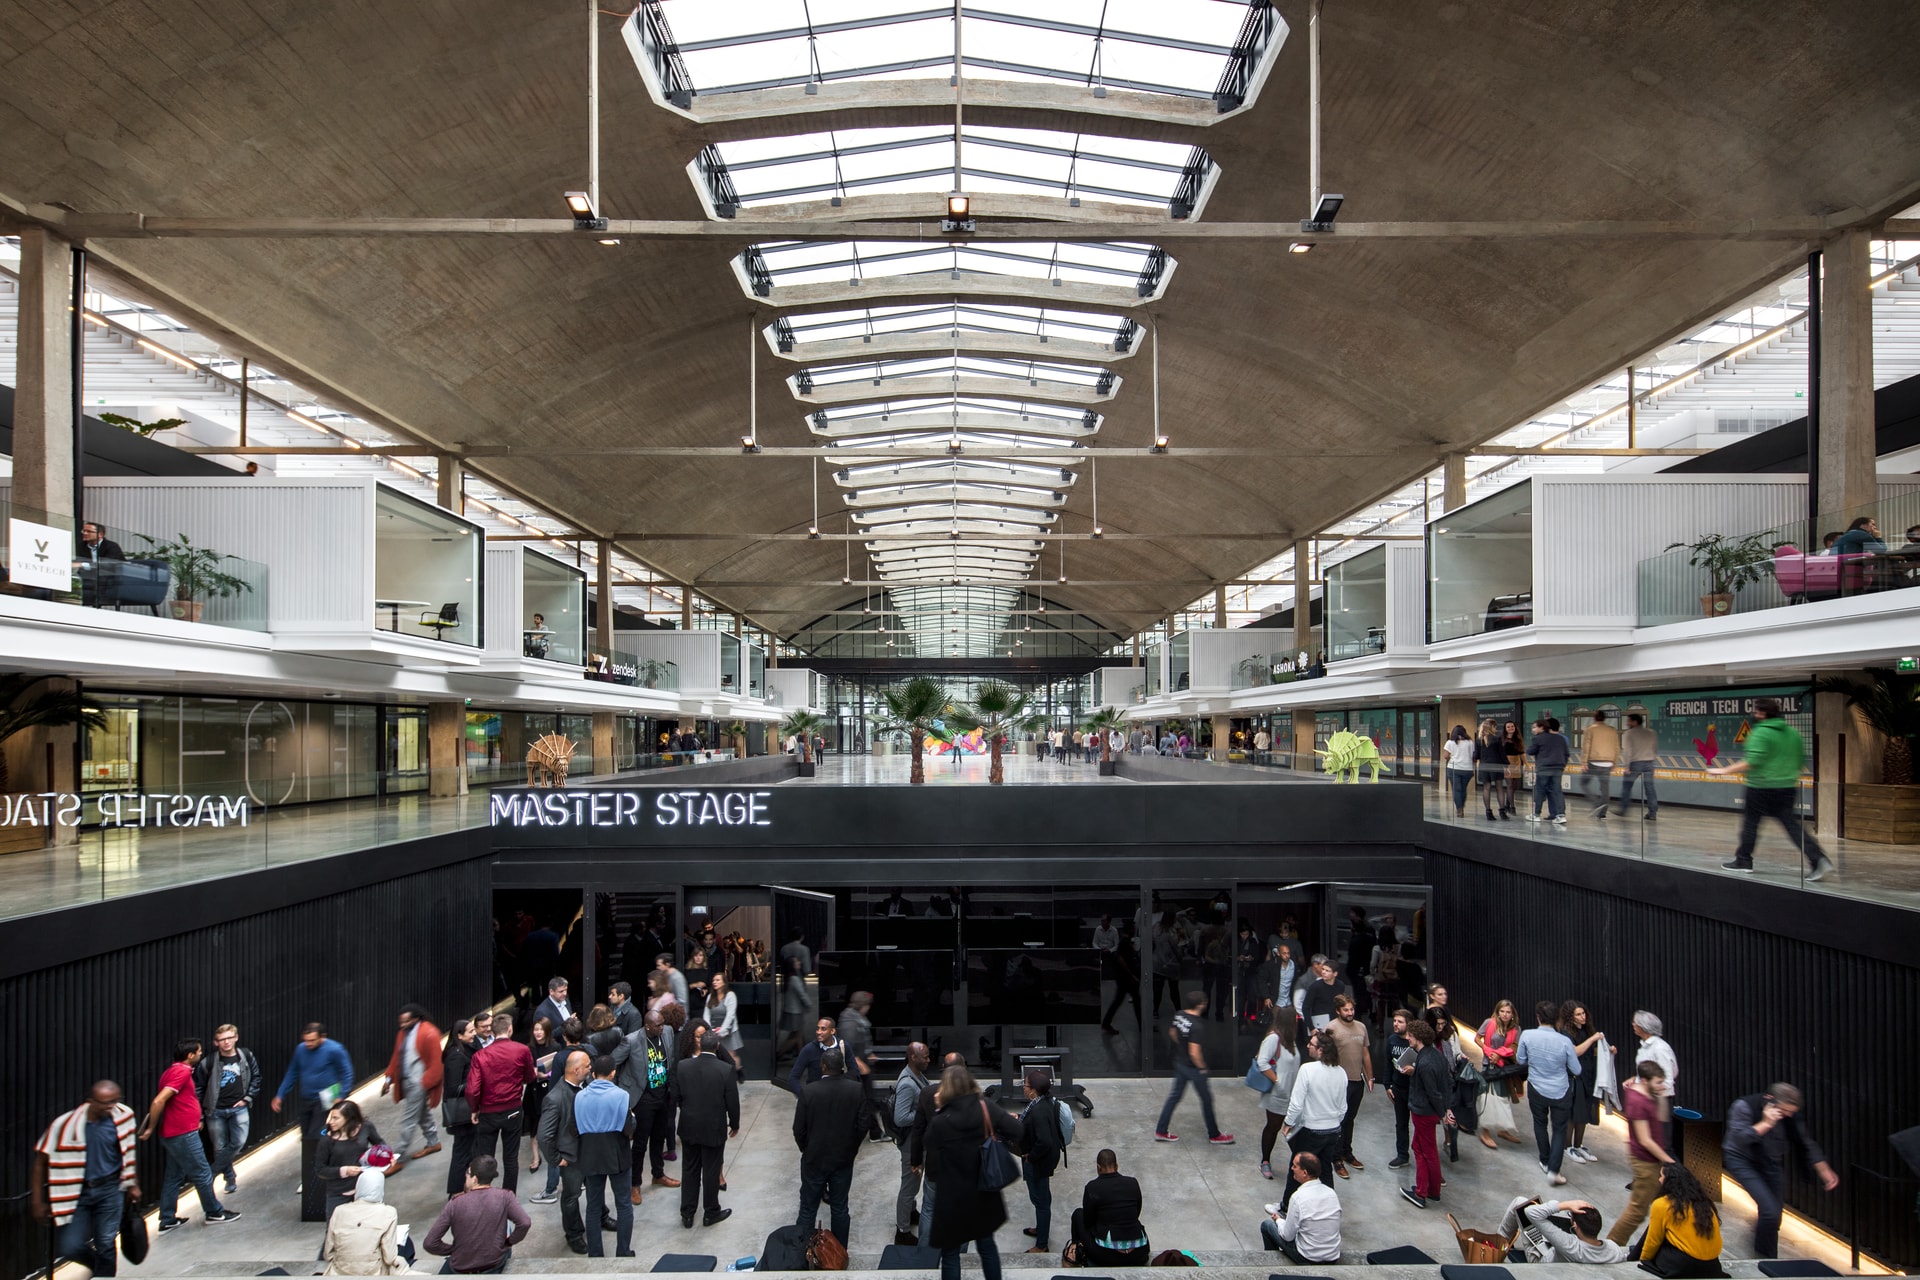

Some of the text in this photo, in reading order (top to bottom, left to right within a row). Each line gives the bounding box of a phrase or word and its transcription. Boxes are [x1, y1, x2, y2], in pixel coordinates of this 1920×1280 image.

[17, 561, 66, 577] VENTECH
[612, 662, 637, 678] zendesk
[1272, 660, 1296, 675] ASHOKA
[1669, 697, 1798, 716] FRENCH TECH CERAL
[490, 791, 772, 827] MASTER STAGE
